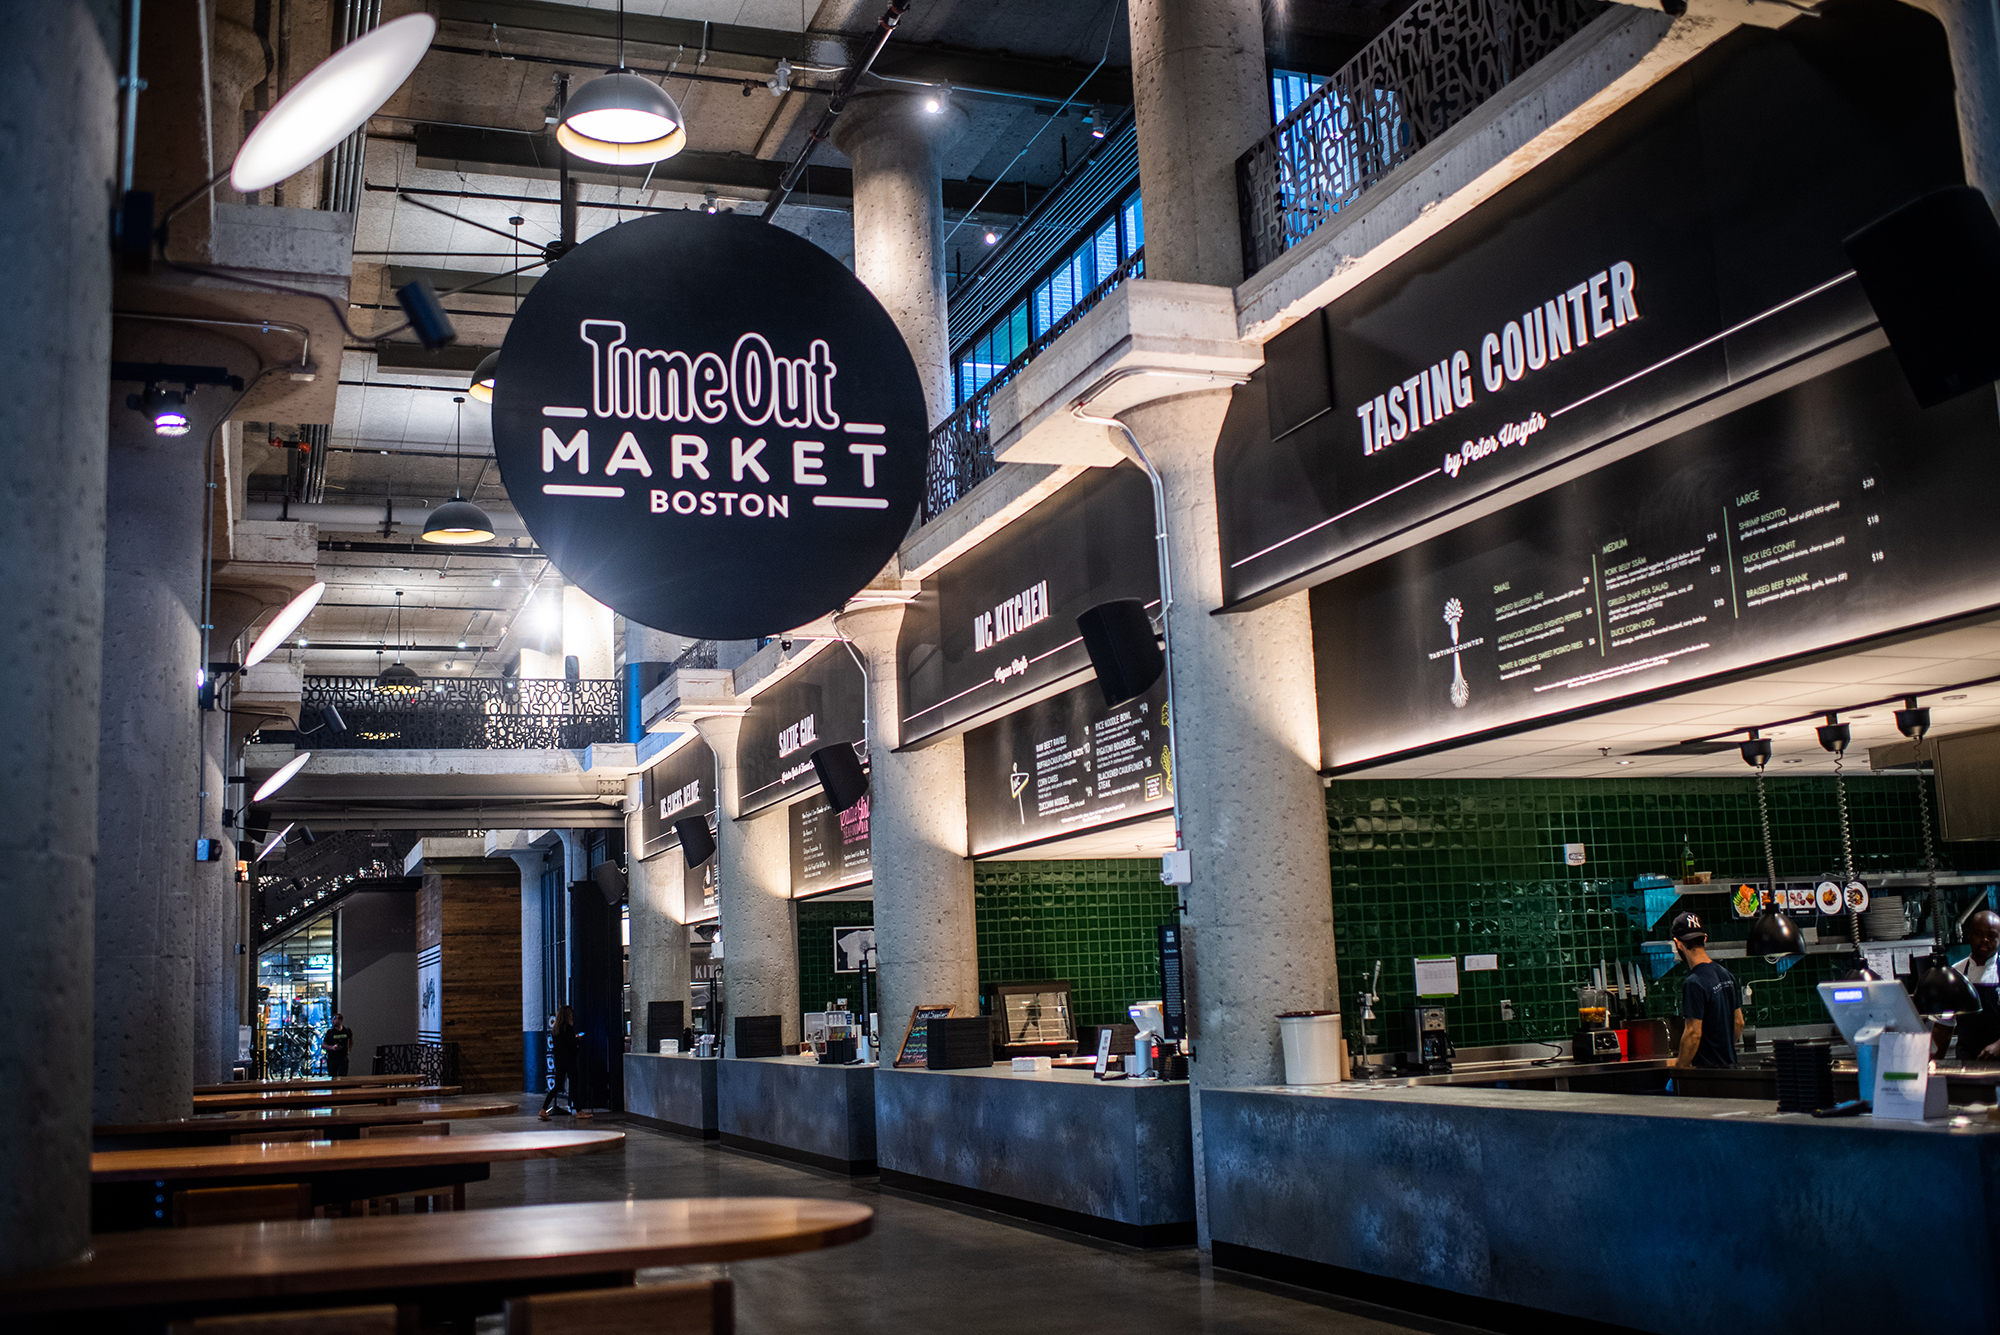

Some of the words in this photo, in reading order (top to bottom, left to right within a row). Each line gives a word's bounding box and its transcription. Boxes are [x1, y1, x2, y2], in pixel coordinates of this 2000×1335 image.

[1357, 350, 1474, 456] TASTING
[1481, 261, 1639, 392] COUNTER
[542, 427, 886, 488] MARKET
[1444, 453, 1462, 478] by
[1461, 435, 1498, 465] Peter
[651, 489, 789, 518] BOSTON
[1736, 490, 1760, 506] LARGE
[1738, 517, 1759, 530] SHRIMP
[1761, 507, 1786, 522] RISOTTO
[1602, 538, 1628, 554] MEDIUM
[1742, 551, 1759, 563] DUCK
[1760, 548, 1771, 558] LEG
[1773, 539, 1795, 554] CONFIT
[1652, 581, 1668, 593] SALAD
[1746, 584, 1769, 598] BRAISED
[1771, 579, 1784, 590] BEEF
[1786, 572, 1808, 585] SHANK
[974, 611, 993, 652] MC
[995, 580, 1049, 642] KITCHEN
[1610, 626, 1624, 637] DUCK
[1642, 617, 1655, 627] DOG
[1120, 710, 1131, 722] BOWL
[800, 714, 816, 746] GIRL
[1686, 914, 1702, 928] NY
